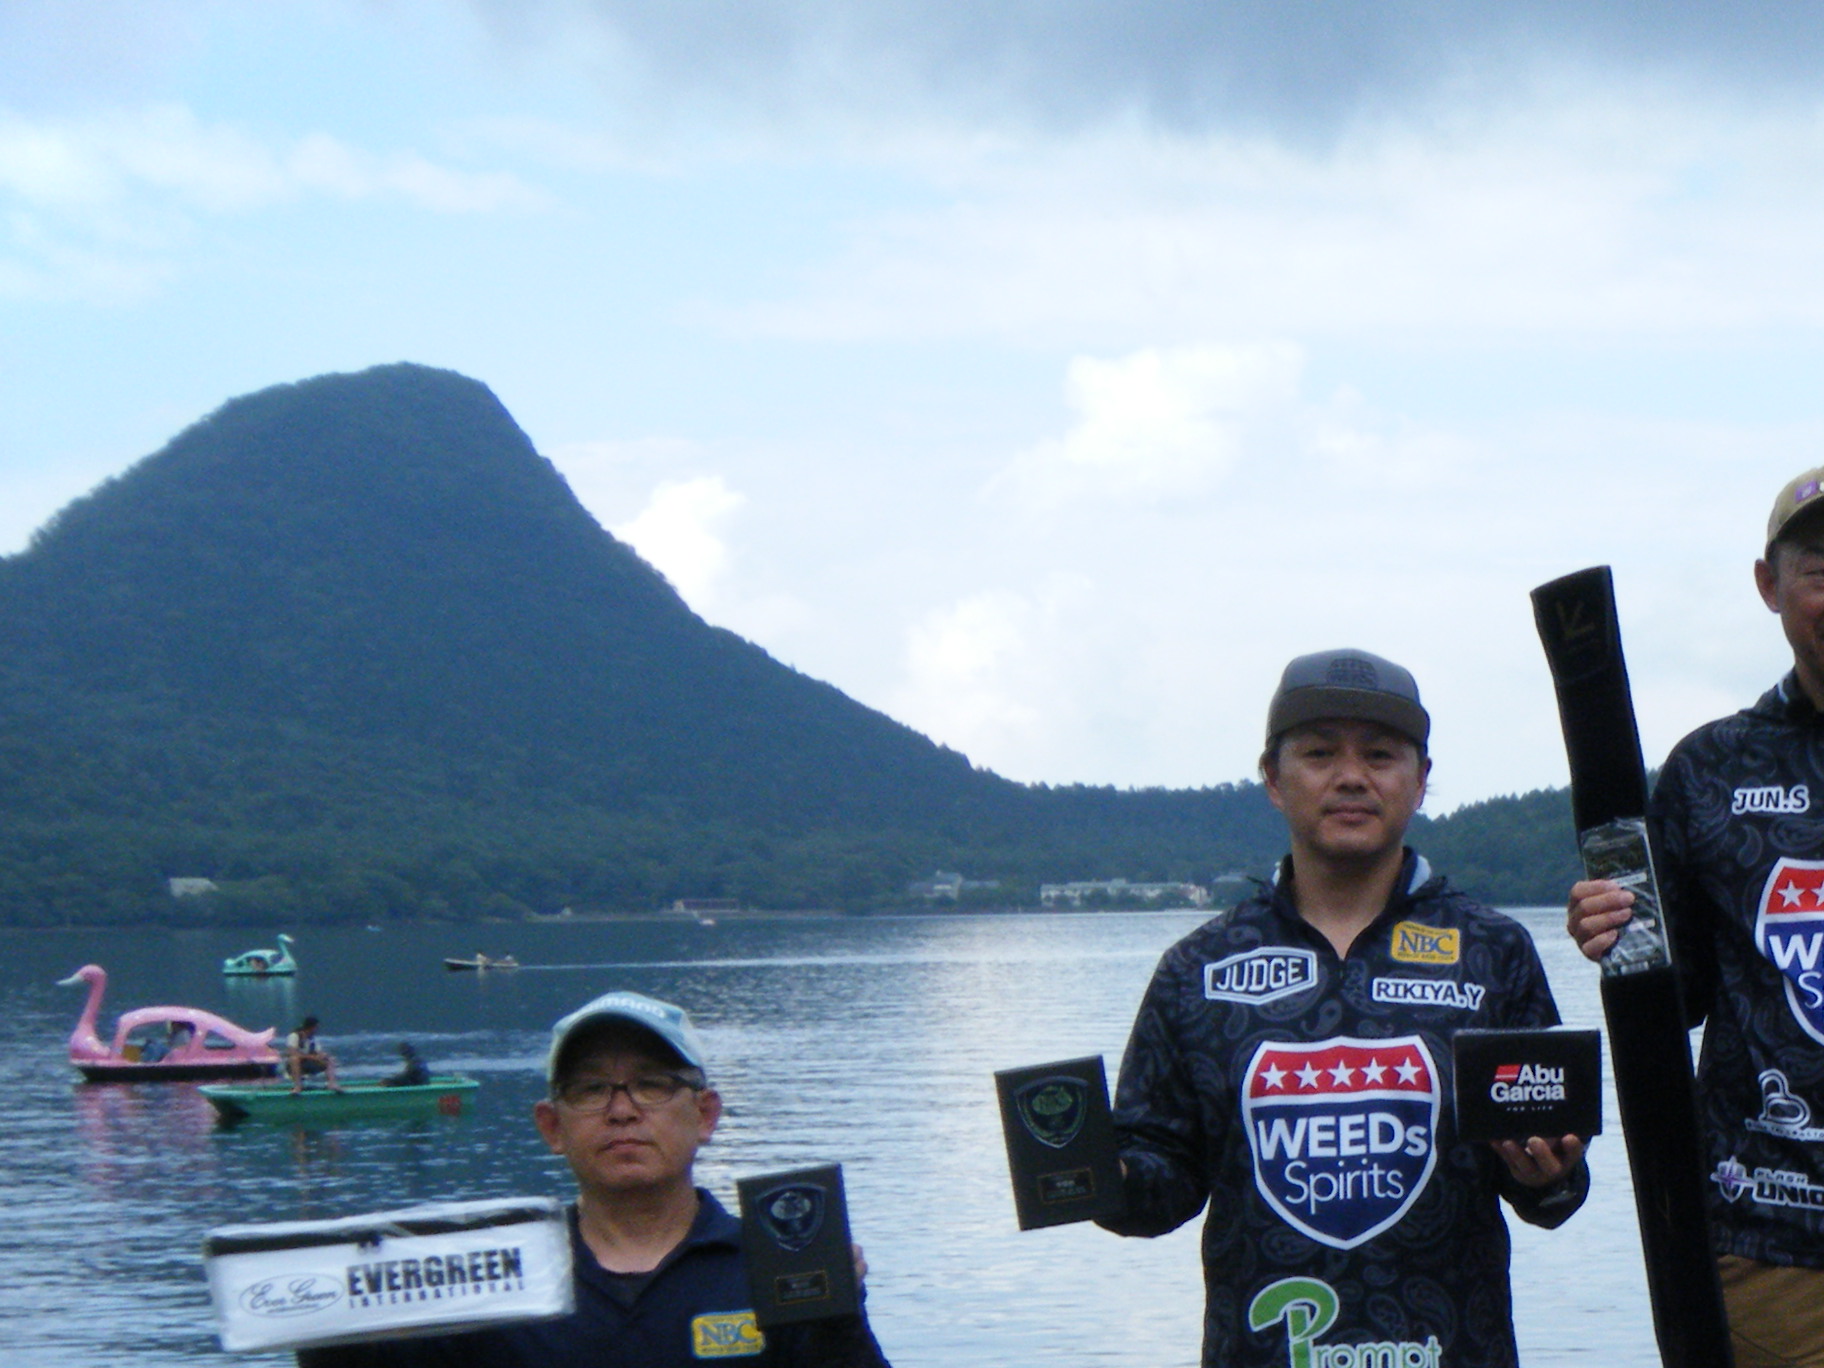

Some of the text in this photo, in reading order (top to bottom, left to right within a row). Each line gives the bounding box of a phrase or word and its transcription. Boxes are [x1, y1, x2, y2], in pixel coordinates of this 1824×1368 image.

[1735, 787, 1806, 811] JUN.S
[1399, 930, 1454, 954] NBC
[1216, 957, 1303, 991] JUDGE
[1517, 1063, 1564, 1085] Abu
[1490, 1081, 1566, 1103] Garcia
[1257, 1112, 1429, 1161] WEEDs
[1284, 1158, 1405, 1216] Spirits
[346, 1247, 523, 1297] EVERGREEN
[700, 1317, 758, 1346] NBC
